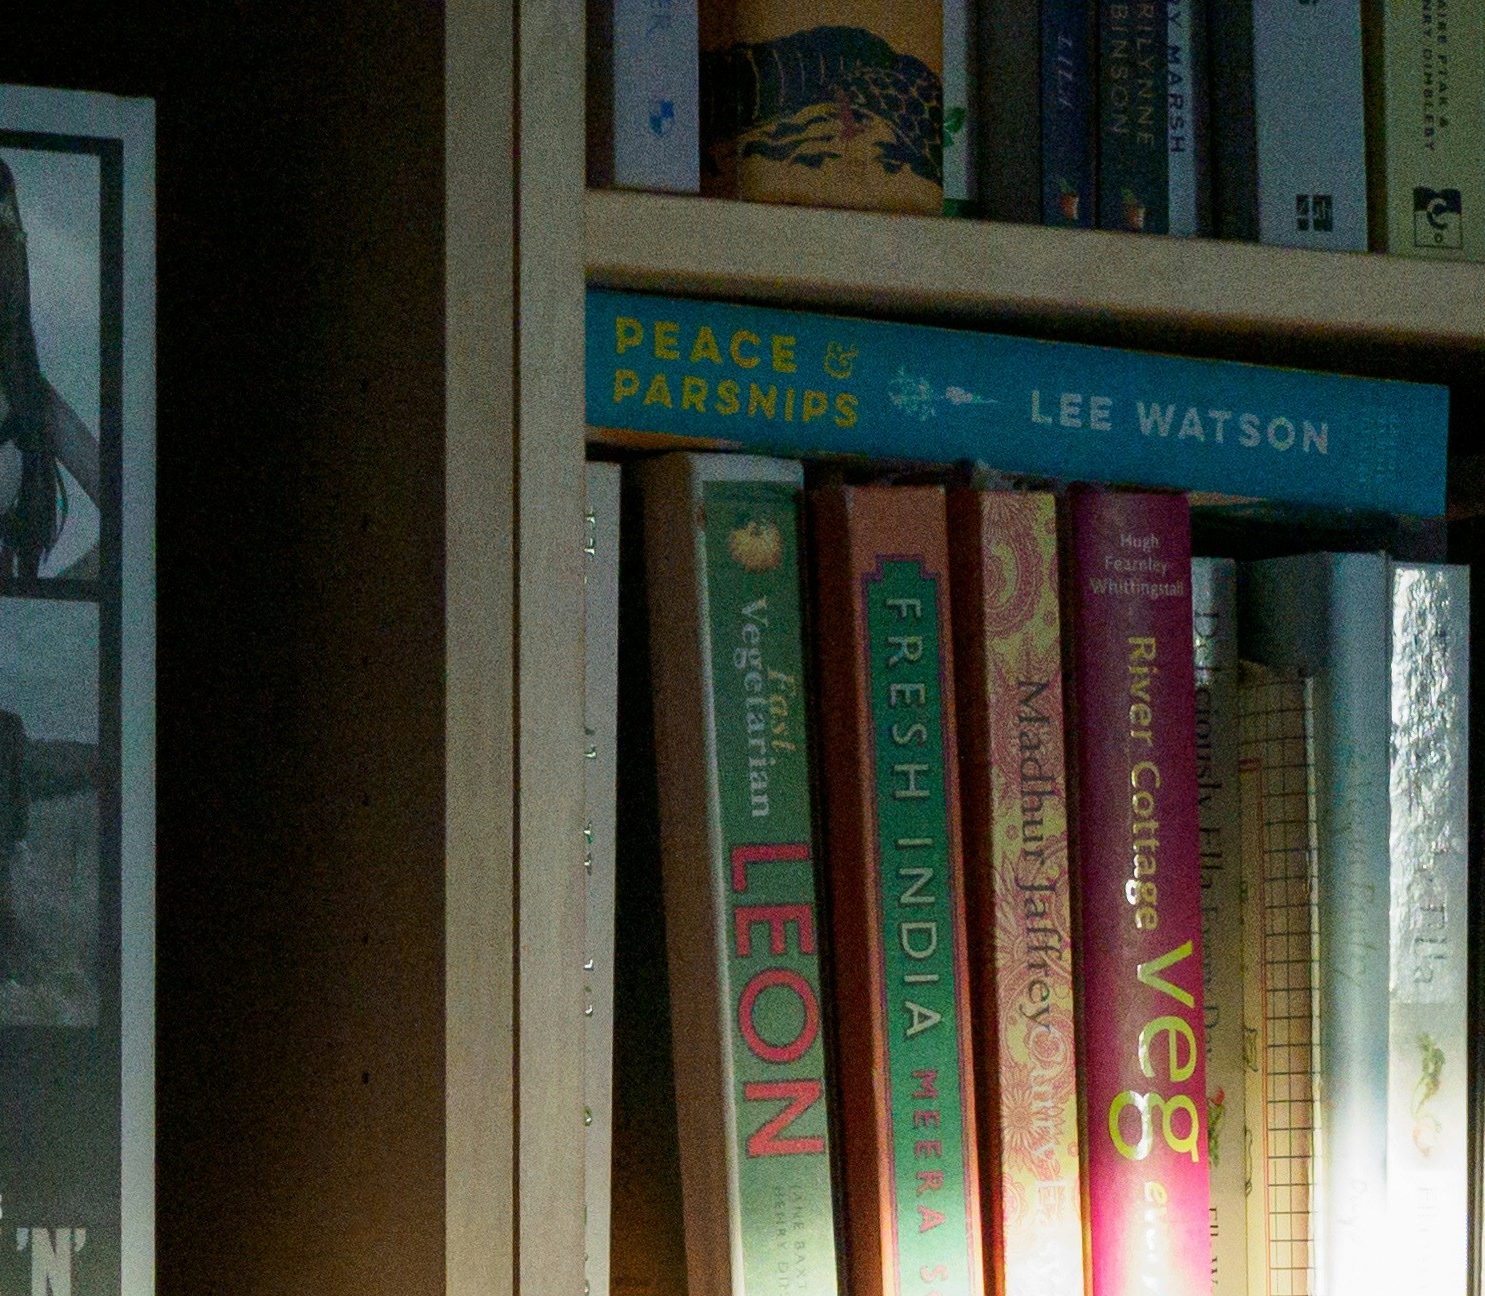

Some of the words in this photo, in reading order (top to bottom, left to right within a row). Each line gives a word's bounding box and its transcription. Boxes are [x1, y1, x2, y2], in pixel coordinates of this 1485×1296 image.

[613, 368, 860, 428] PARSNIPS
[615, 316, 800, 373] PEACE
[1031, 388, 1113, 432] LEE
[1137, 401, 1330, 455] WATSON
[1119, 531, 1161, 551] Hugh
[736, 595, 778, 819] Vegetarian
[764, 668, 801, 753] Fast
[884, 595, 932, 801] FRESH
[1013, 678, 1063, 865] Madhur
[727, 842, 828, 1159] LEON
[897, 835, 943, 1037] INDIA
[1013, 875, 1063, 1032] Jaffrey
[909, 1068, 947, 1235] MEERA
